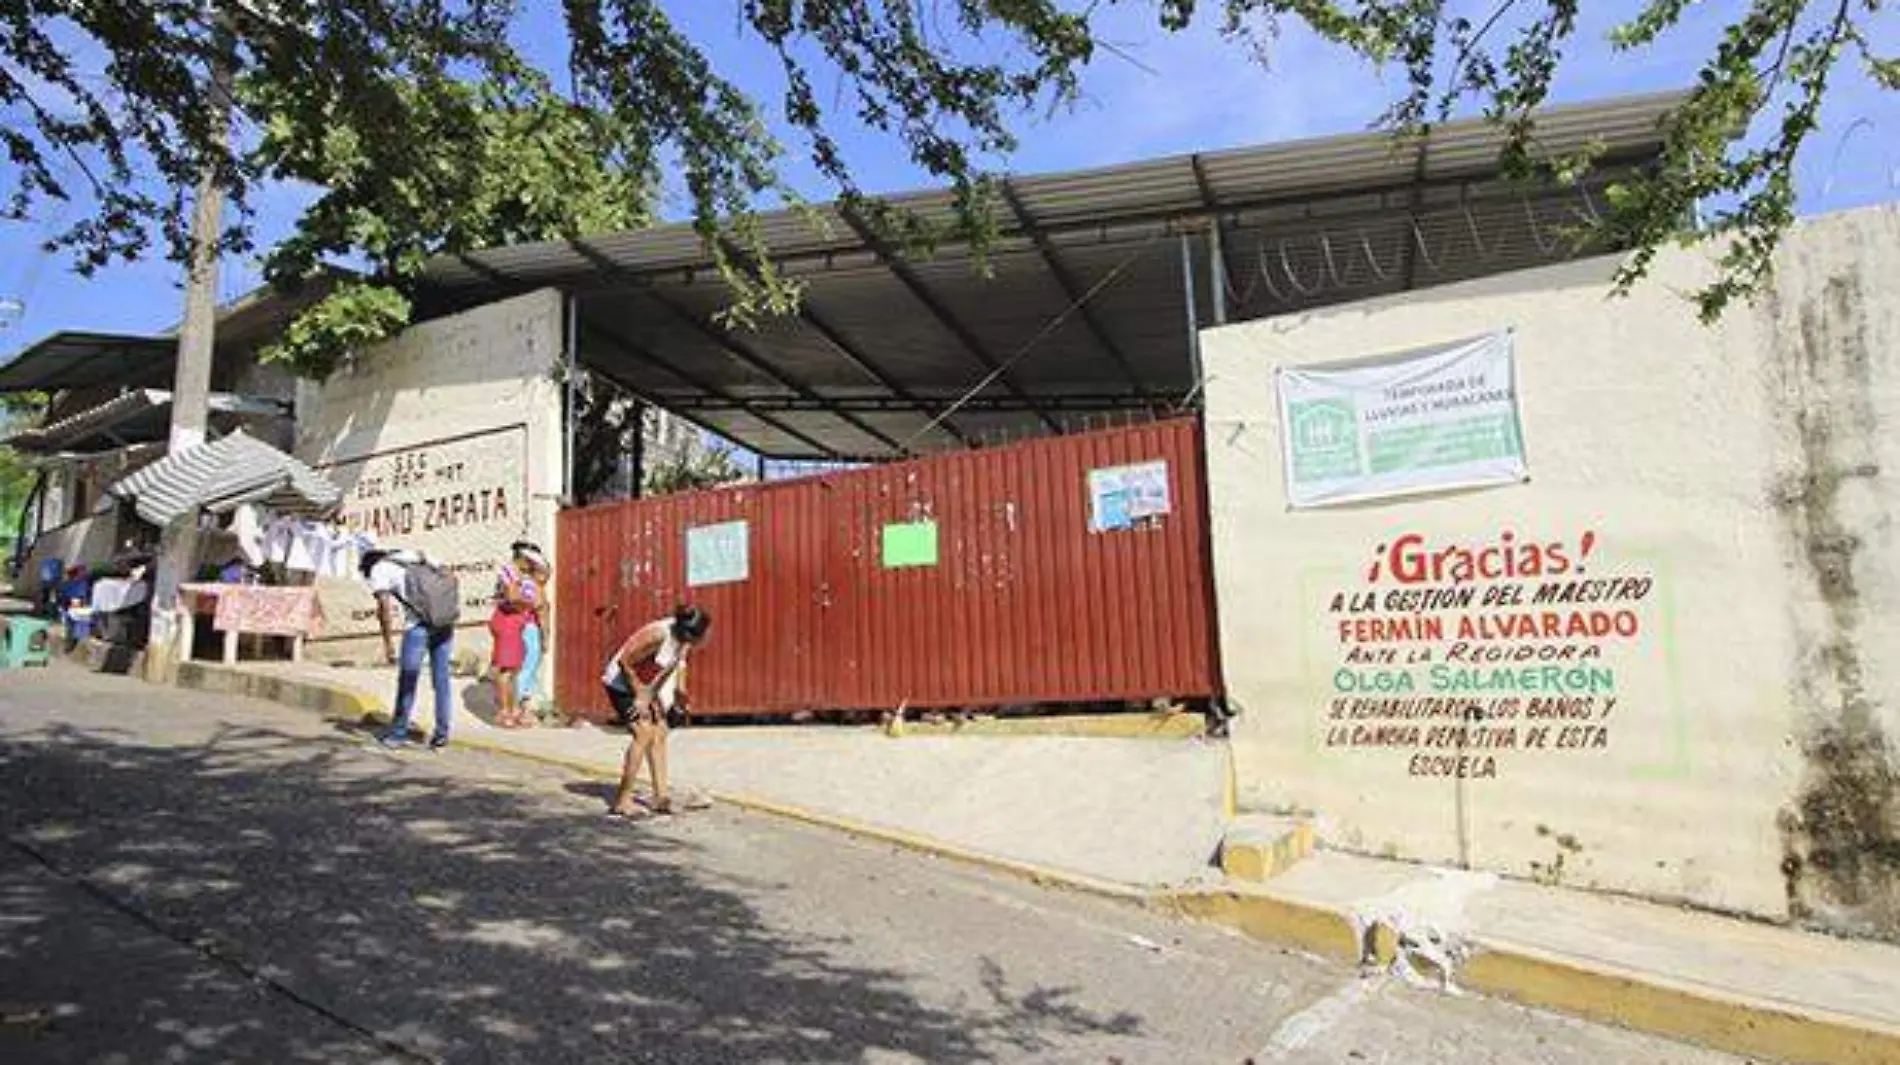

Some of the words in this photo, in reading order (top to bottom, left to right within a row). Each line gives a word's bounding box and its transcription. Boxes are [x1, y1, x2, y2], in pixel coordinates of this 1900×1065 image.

[1384, 378, 1465, 401] TEMPORADA
[1365, 402, 1418, 421] LLUVIAS
[424, 487, 508, 531] ZAPATA
[1368, 530, 1595, 583] ¡Gracias!
[1329, 592, 1344, 612] A
[1349, 591, 1377, 612] LA
[1481, 584, 1524, 607] DEL
[1532, 576, 1653, 604] MAESTRO
[1457, 609, 1639, 640] ALVARADO
[1346, 648, 1395, 664] ANTE
[1406, 648, 1433, 663] LA
[1446, 641, 1602, 663] REGIDORA
[1333, 667, 1415, 693] OLGA
[1600, 696, 1617, 718] Y
[1525, 726, 1550, 748] DE
[1556, 725, 1608, 749] ESTA
[1408, 754, 1497, 779] ESCUELA
